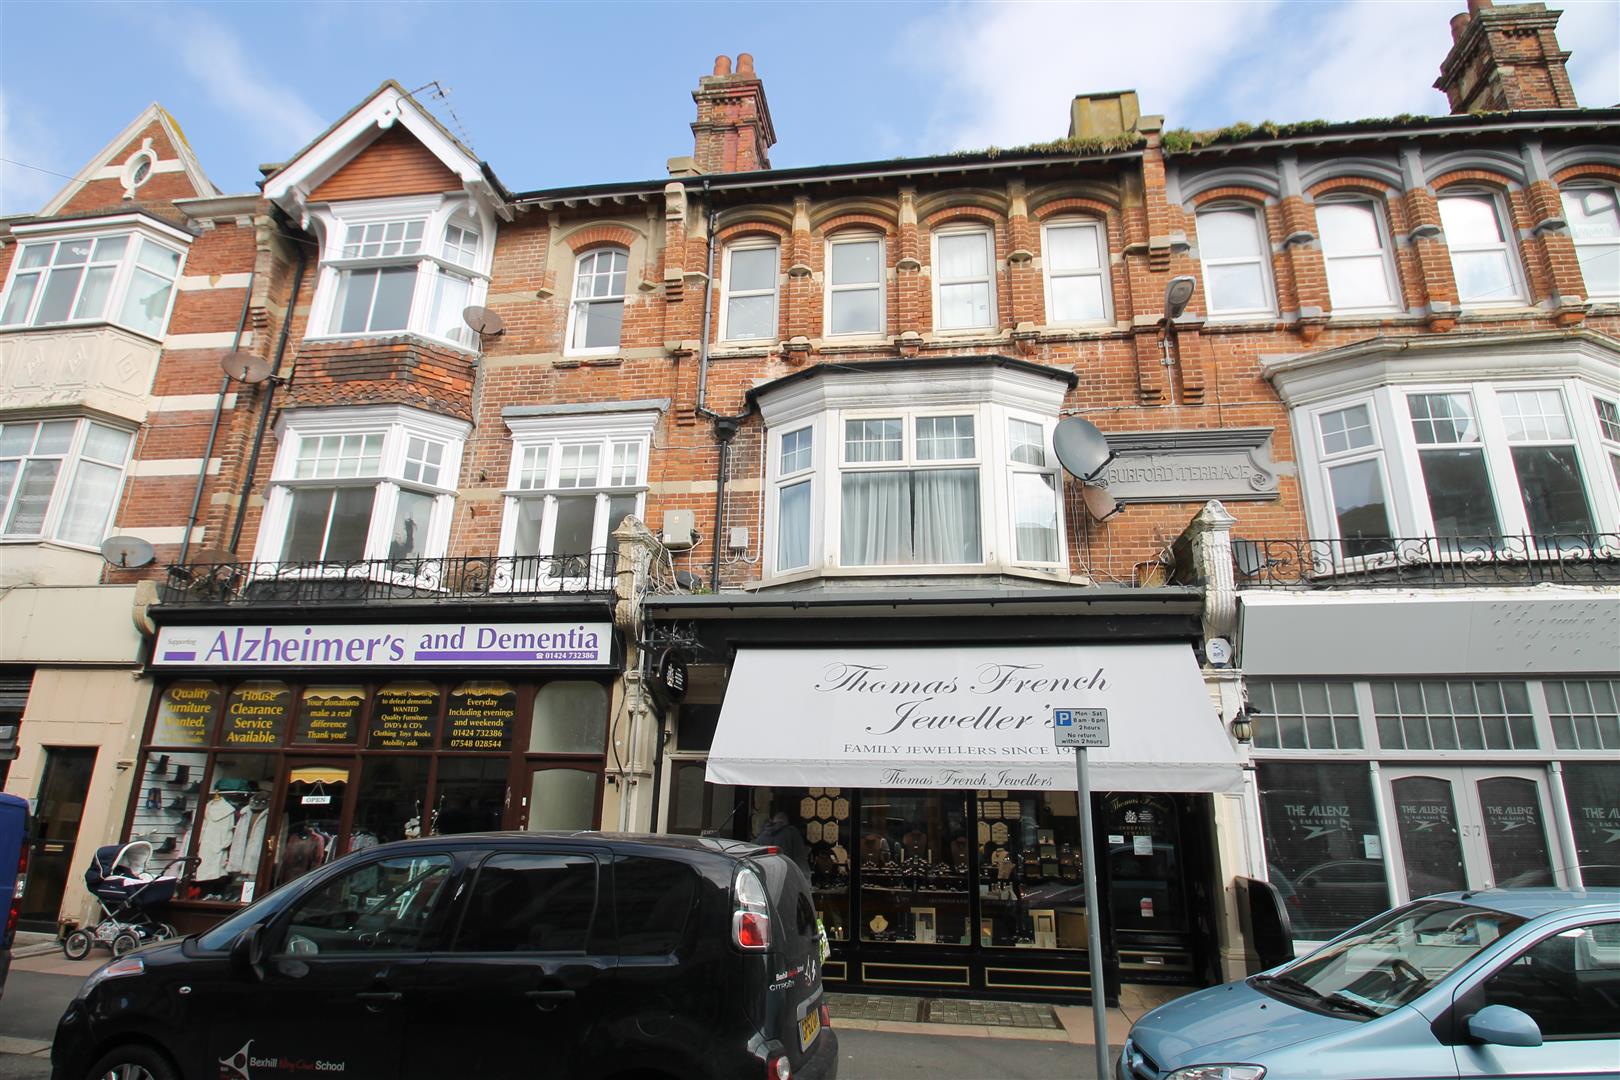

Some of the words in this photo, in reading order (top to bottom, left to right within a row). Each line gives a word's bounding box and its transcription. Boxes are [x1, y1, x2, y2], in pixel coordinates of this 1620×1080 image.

[1109, 466, 1173, 483] BURFORD
[1178, 465, 1251, 481] TERRACE
[204, 627, 405, 662] Alzheimer's
[419, 626, 466, 650] and
[476, 625, 599, 650] Dementia
[545, 652, 567, 660] 01424
[568, 652, 595, 660] 732386
[814, 661, 958, 694] Thomas
[969, 662, 1112, 694] French
[171, 687, 209, 701] Quality
[242, 689, 277, 701] House
[324, 698, 360, 706] donations
[467, 698, 498, 707] Everyday
[230, 703, 284, 715] Clearance
[310, 709, 329, 717] make
[337, 709, 353, 717] real
[449, 708, 482, 717] Including
[483, 709, 514, 718] evenings
[234, 717, 273, 729] Service
[310, 719, 348, 728] difference
[454, 718, 469, 726] and
[470, 719, 505, 727] weekends
[226, 731, 276, 743] Available
[307, 731, 329, 739] Thank
[373, 730, 397, 738] Clothing
[453, 729, 474, 737] 01424
[476, 729, 503, 737] 732386
[383, 739, 405, 747] Mobility
[451, 739, 473, 747] 07548
[475, 739, 502, 748] 028544
[844, 743, 901, 754] FAMILY
[905, 745, 997, 755] JEWELLERS
[1001, 746, 1050, 756] SINCE
[880, 768, 933, 786] Thomas
[936, 769, 987, 786] French
[988, 769, 1052, 788] Jewellers
[1284, 805, 1306, 817] THE
[1309, 805, 1351, 817] ALLENZ
[1401, 805, 1418, 814] THE
[1418, 805, 1449, 815] ALLENZ
[1487, 806, 1503, 815] THE
[1504, 806, 1535, 815] ALLENZ
[1583, 807, 1605, 819] THE
[250, 1057, 278, 1068] Bexhill
[315, 1060, 345, 1072] School
